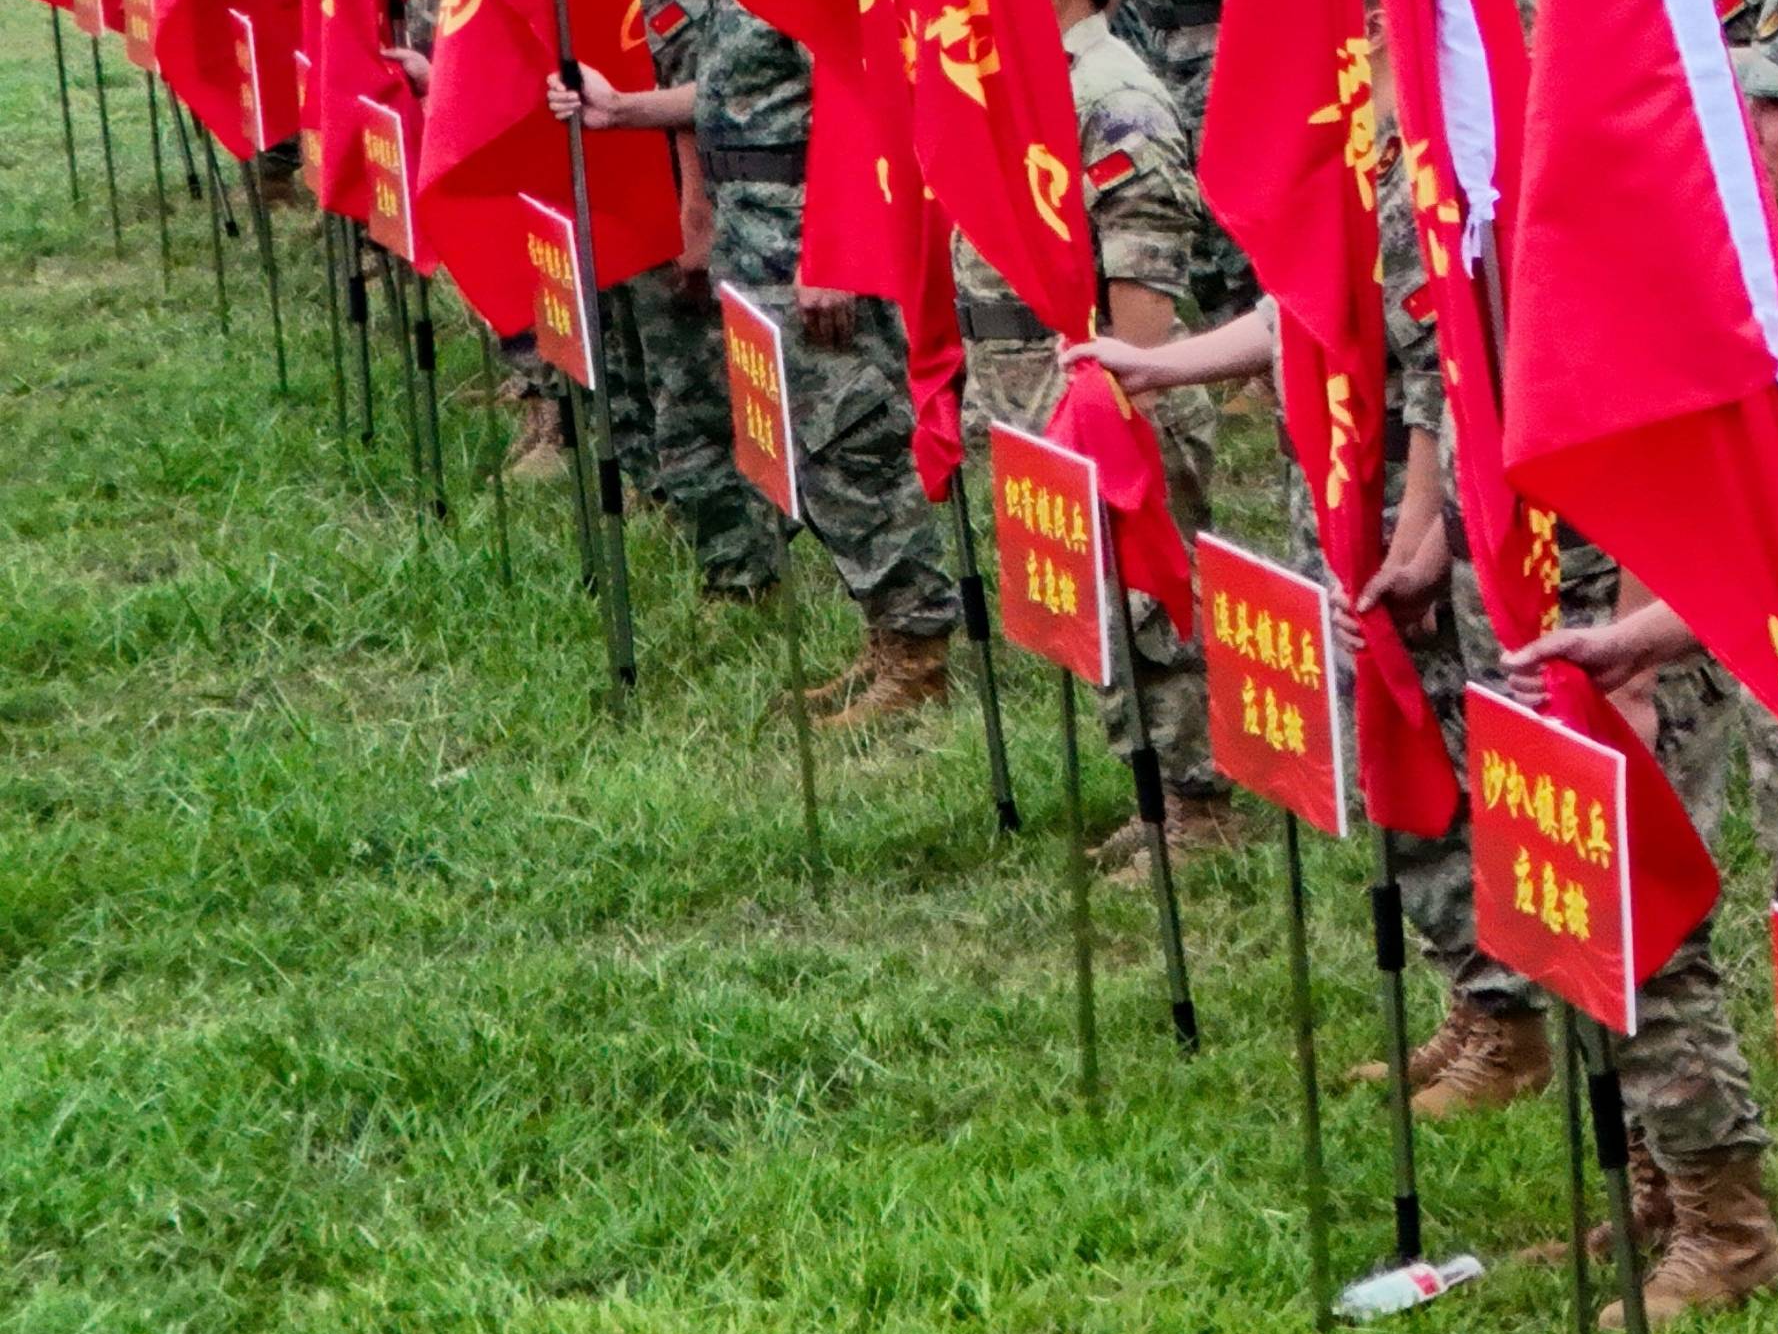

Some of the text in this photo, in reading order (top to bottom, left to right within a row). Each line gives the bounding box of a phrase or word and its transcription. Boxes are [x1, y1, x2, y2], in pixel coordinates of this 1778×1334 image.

[1026, 549, 1079, 616] 应急排
[1213, 591, 1321, 690] 溪头镇民兵
[1242, 674, 1306, 756] 应急排
[1481, 748, 1614, 869] 沙扒镇民兵
[1513, 846, 1591, 942] 应急排
